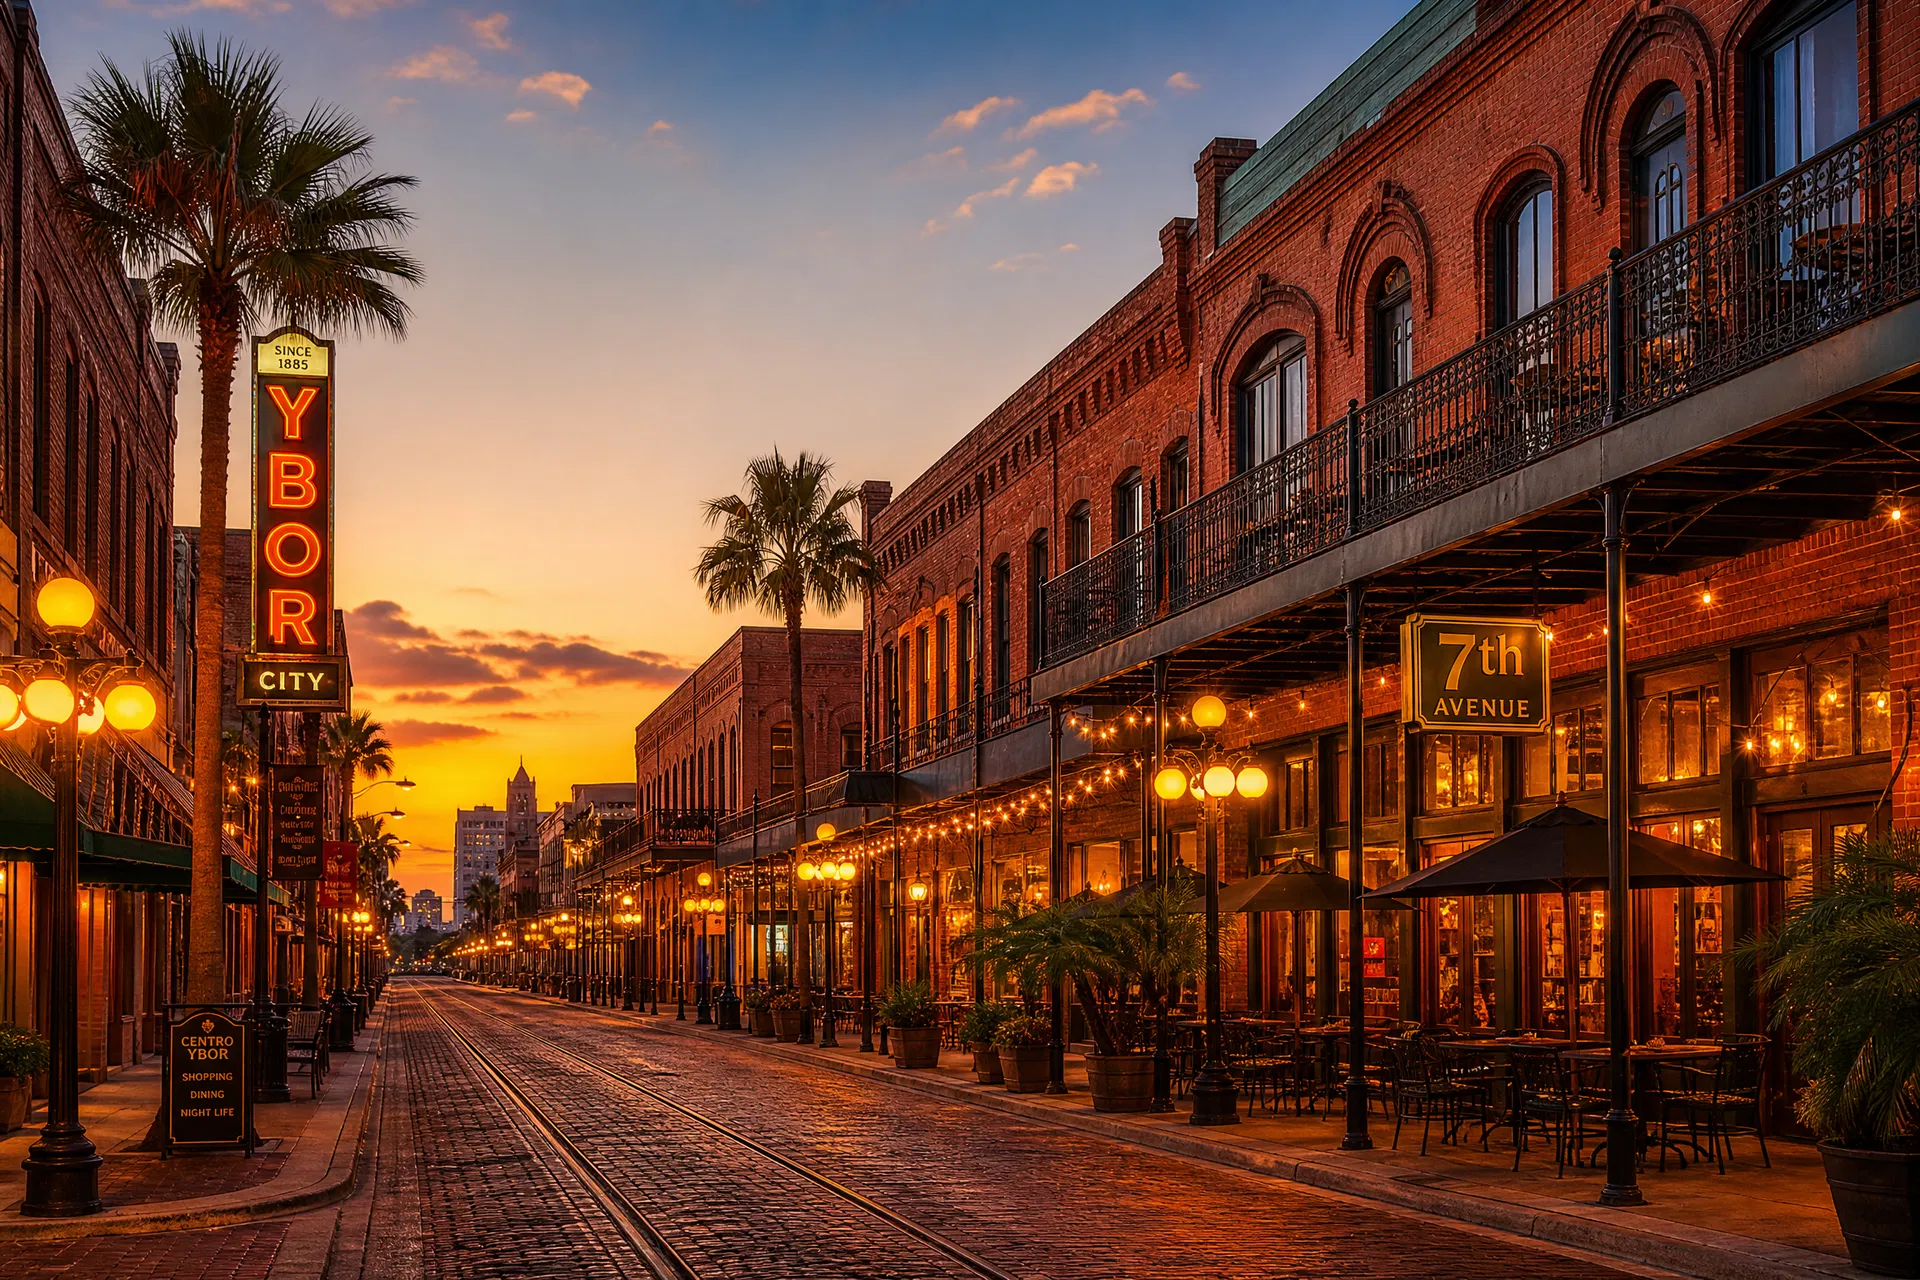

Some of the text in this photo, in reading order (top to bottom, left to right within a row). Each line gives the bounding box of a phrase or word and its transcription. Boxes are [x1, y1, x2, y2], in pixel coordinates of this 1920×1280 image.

[275, 345, 311, 357] SINCE
[278, 358, 308, 370] 1885
[264, 384, 322, 646] YBOR
[1438, 632, 1524, 691] 7th
[259, 671, 325, 692] CITY
[1433, 697, 1530, 718] AVENUE
[181, 1036, 234, 1047] CENTRO
[187, 1048, 229, 1060] YBOR
[182, 1072, 233, 1081] SHOPPING
[190, 1090, 225, 1099] DINING
[181, 1108, 234, 1117] NIGHT LIFE
